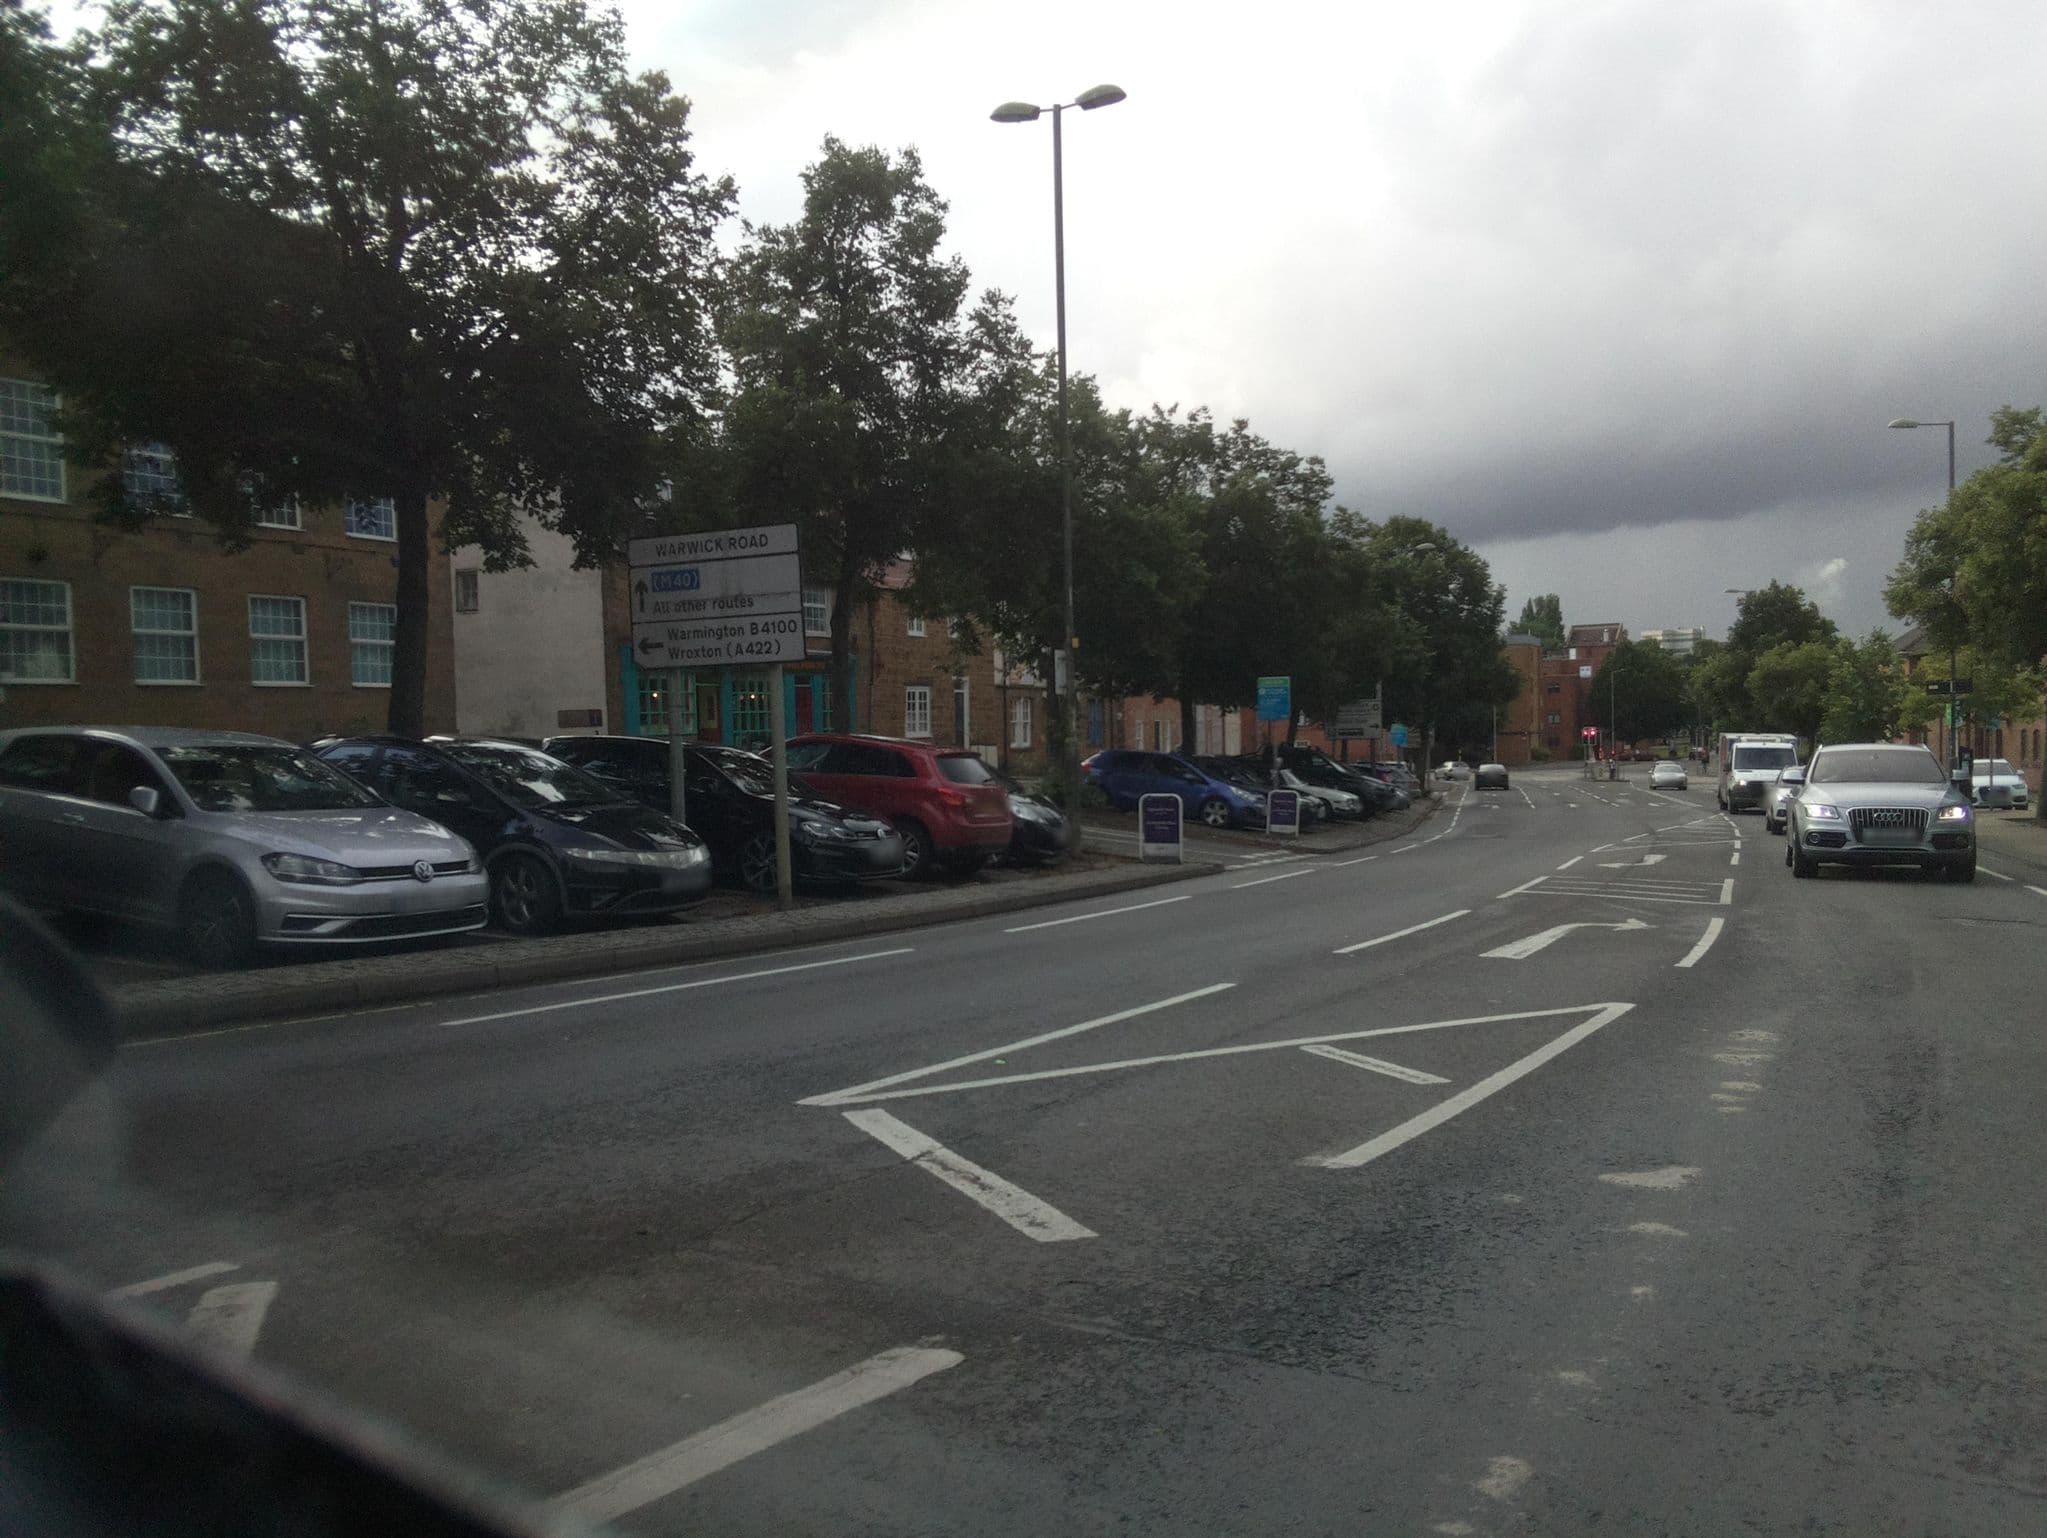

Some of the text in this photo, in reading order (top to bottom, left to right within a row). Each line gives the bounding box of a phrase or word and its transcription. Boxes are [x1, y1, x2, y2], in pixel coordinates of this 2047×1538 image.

[655, 534, 769, 557] WARWICK ROAD
[653, 570, 699, 588] (M40)
[653, 596, 754, 615] All other routes
[667, 620, 798, 642] Warmington B4100
[668, 639, 781, 660] Wroxton (A422)
